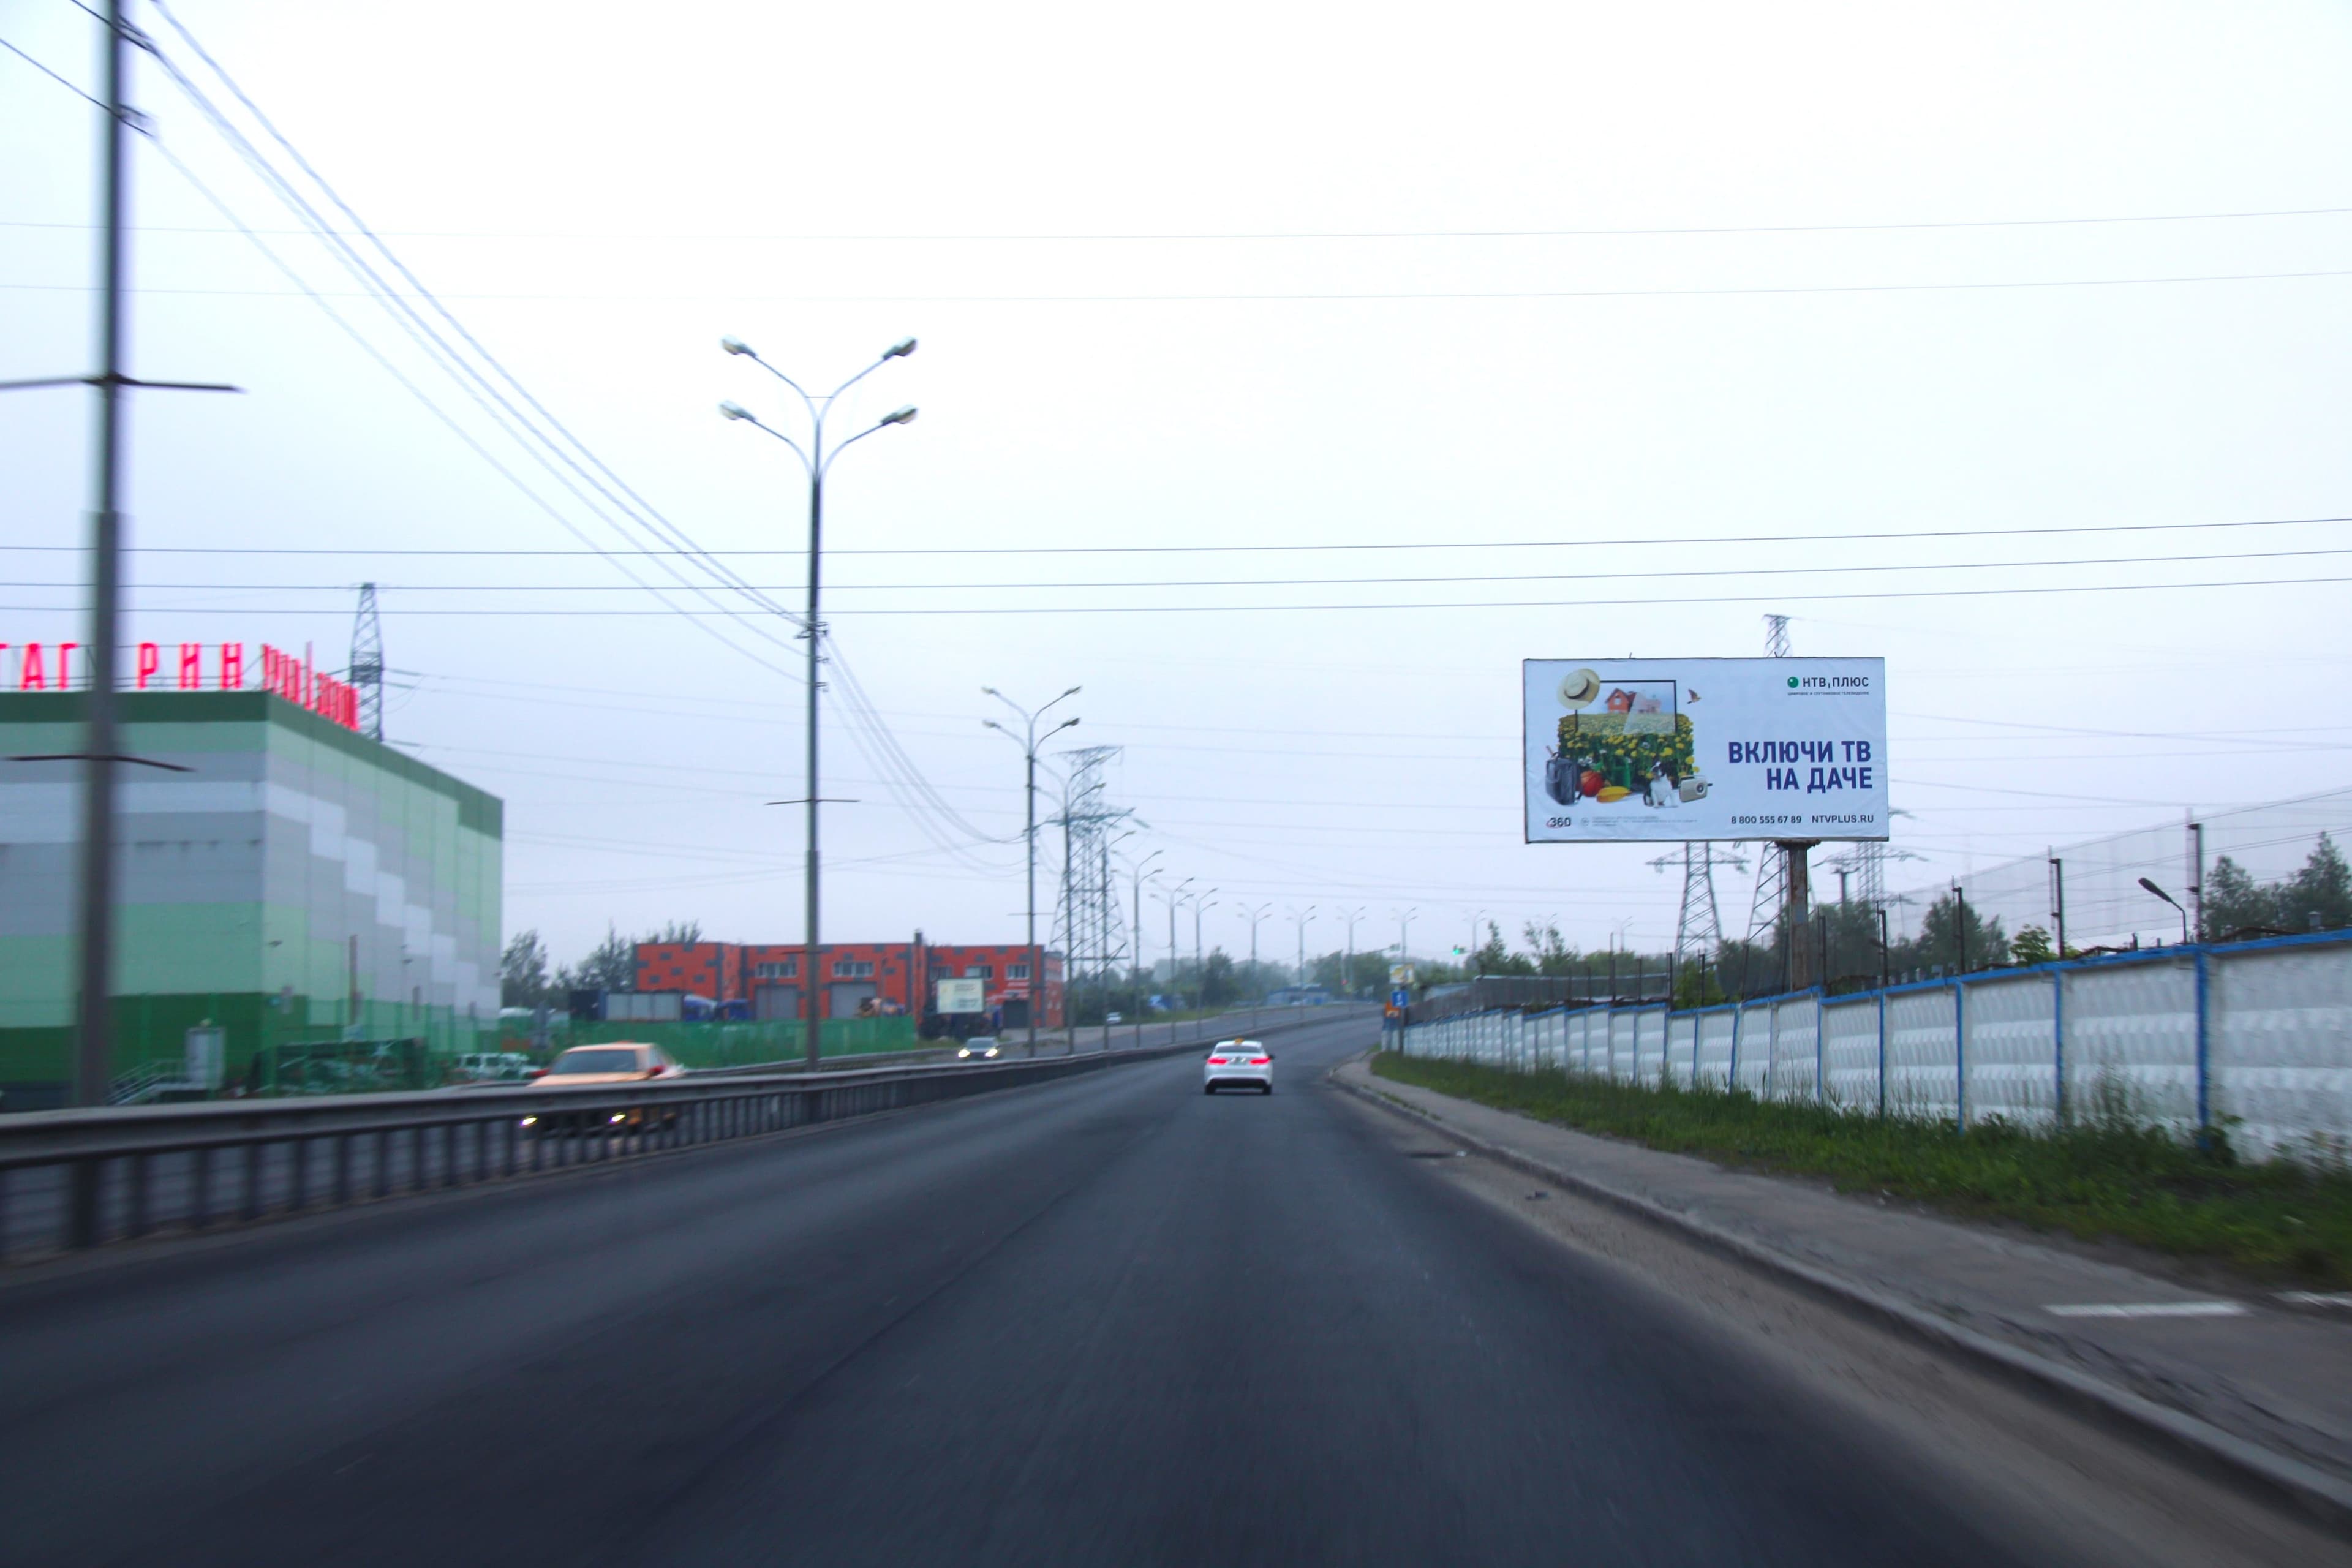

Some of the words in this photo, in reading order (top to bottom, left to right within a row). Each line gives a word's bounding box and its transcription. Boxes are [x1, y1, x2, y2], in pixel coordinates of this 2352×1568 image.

[0, 643, 243, 690] АГРИН
[1728, 741, 1833, 764] ВКЛЮЧИ
[1841, 741, 1872, 763] ТВ
[1766, 767, 1800, 790] НА
[1807, 767, 1873, 794] ДАЧЕ
[1739, 816, 1757, 824] 800
[1759, 816, 1776, 824] 555
[1777, 816, 1788, 824] 67
[1790, 815, 1802, 824] 89
[1811, 815, 1874, 824] NTVPLUS.RU
